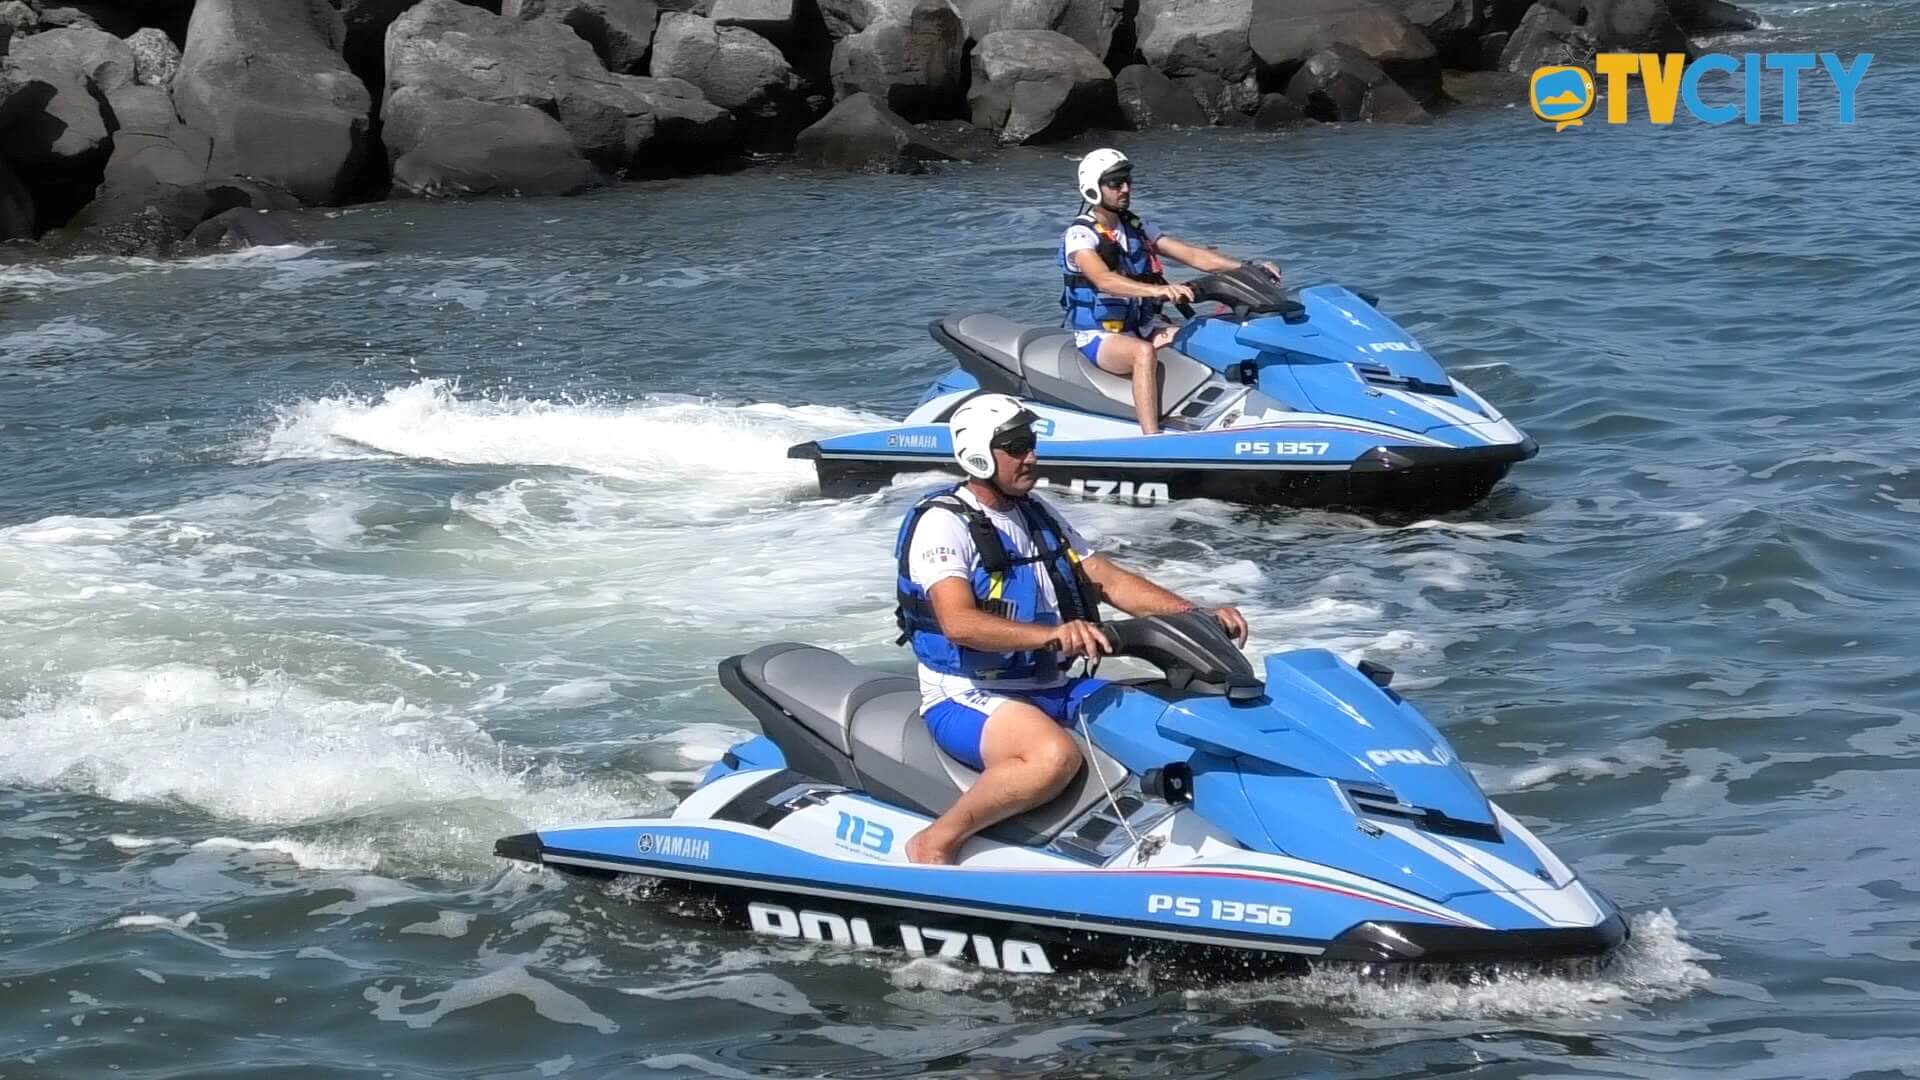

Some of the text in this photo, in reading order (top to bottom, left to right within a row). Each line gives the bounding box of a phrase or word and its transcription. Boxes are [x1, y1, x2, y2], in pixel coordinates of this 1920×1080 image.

[899, 434, 937, 448] YAMAHA
[1235, 441, 1330, 456] PS 1357
[836, 810, 894, 854] 113
[654, 834, 710, 860] YAMAHA
[1148, 894, 1293, 927] PS 1356
